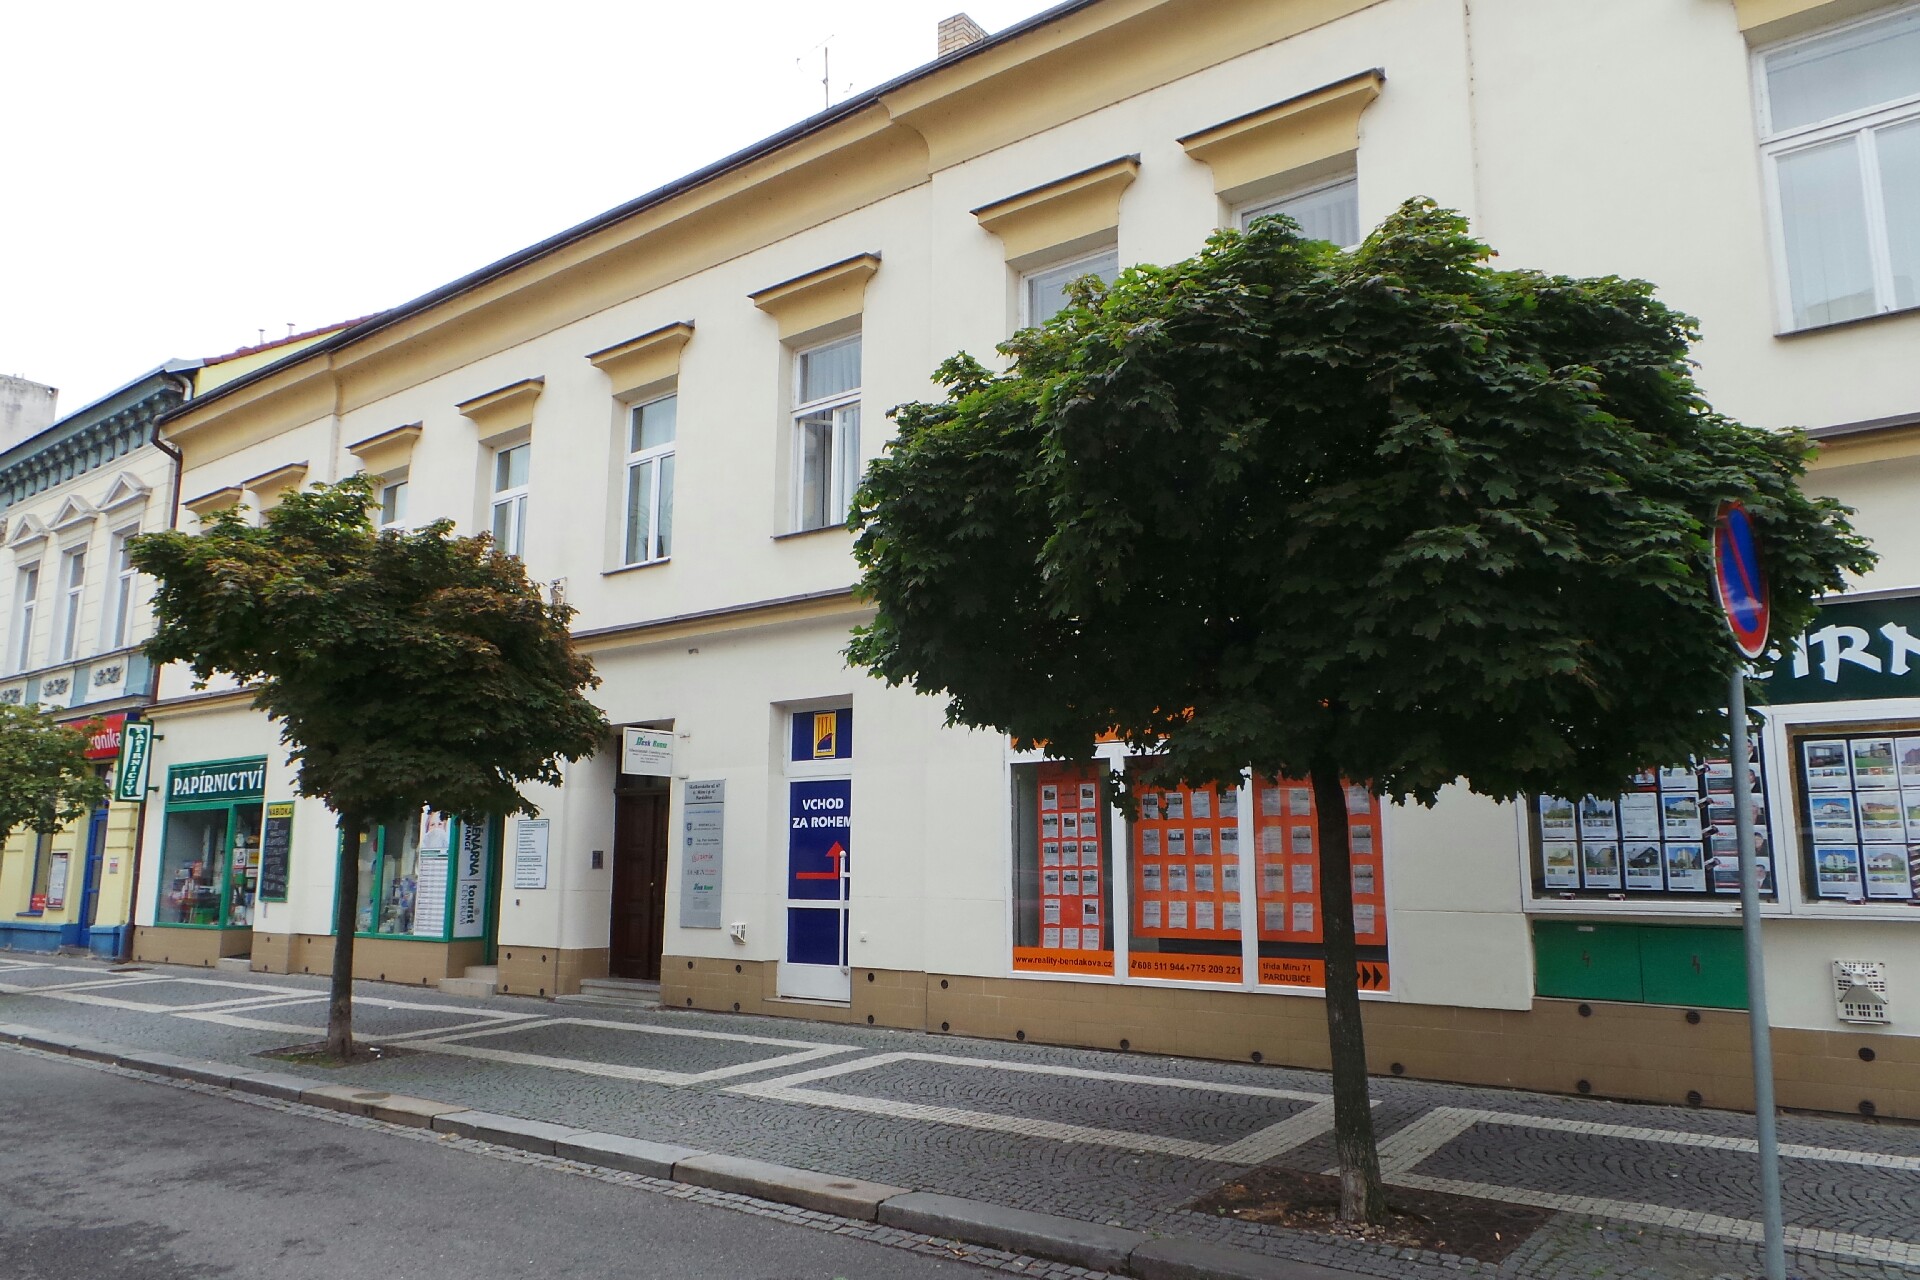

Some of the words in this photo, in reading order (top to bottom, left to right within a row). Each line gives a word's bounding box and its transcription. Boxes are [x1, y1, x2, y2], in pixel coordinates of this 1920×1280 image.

[91, 728, 121, 750] ronika
[172, 764, 264, 796] PAPÍRNICTVÍ
[802, 798, 844, 810] VCHOD
[792, 817, 808, 829] ZA
[811, 815, 851, 828] ROHEM
[469, 824, 484, 876] ĚNÁRNA
[459, 884, 467, 925] CENTRUM
[467, 884, 478, 924] tourist
[1015, 956, 1113, 969] www.reality-bendakova.cz
[1137, 961, 1152, 970] 608
[1154, 962, 1167, 971] 511
[1208, 965, 1223, 974] 209
[1226, 966, 1241, 975] 221
[1302, 964, 1311, 972] 71
[1264, 973, 1311, 984] PARDUBICE
